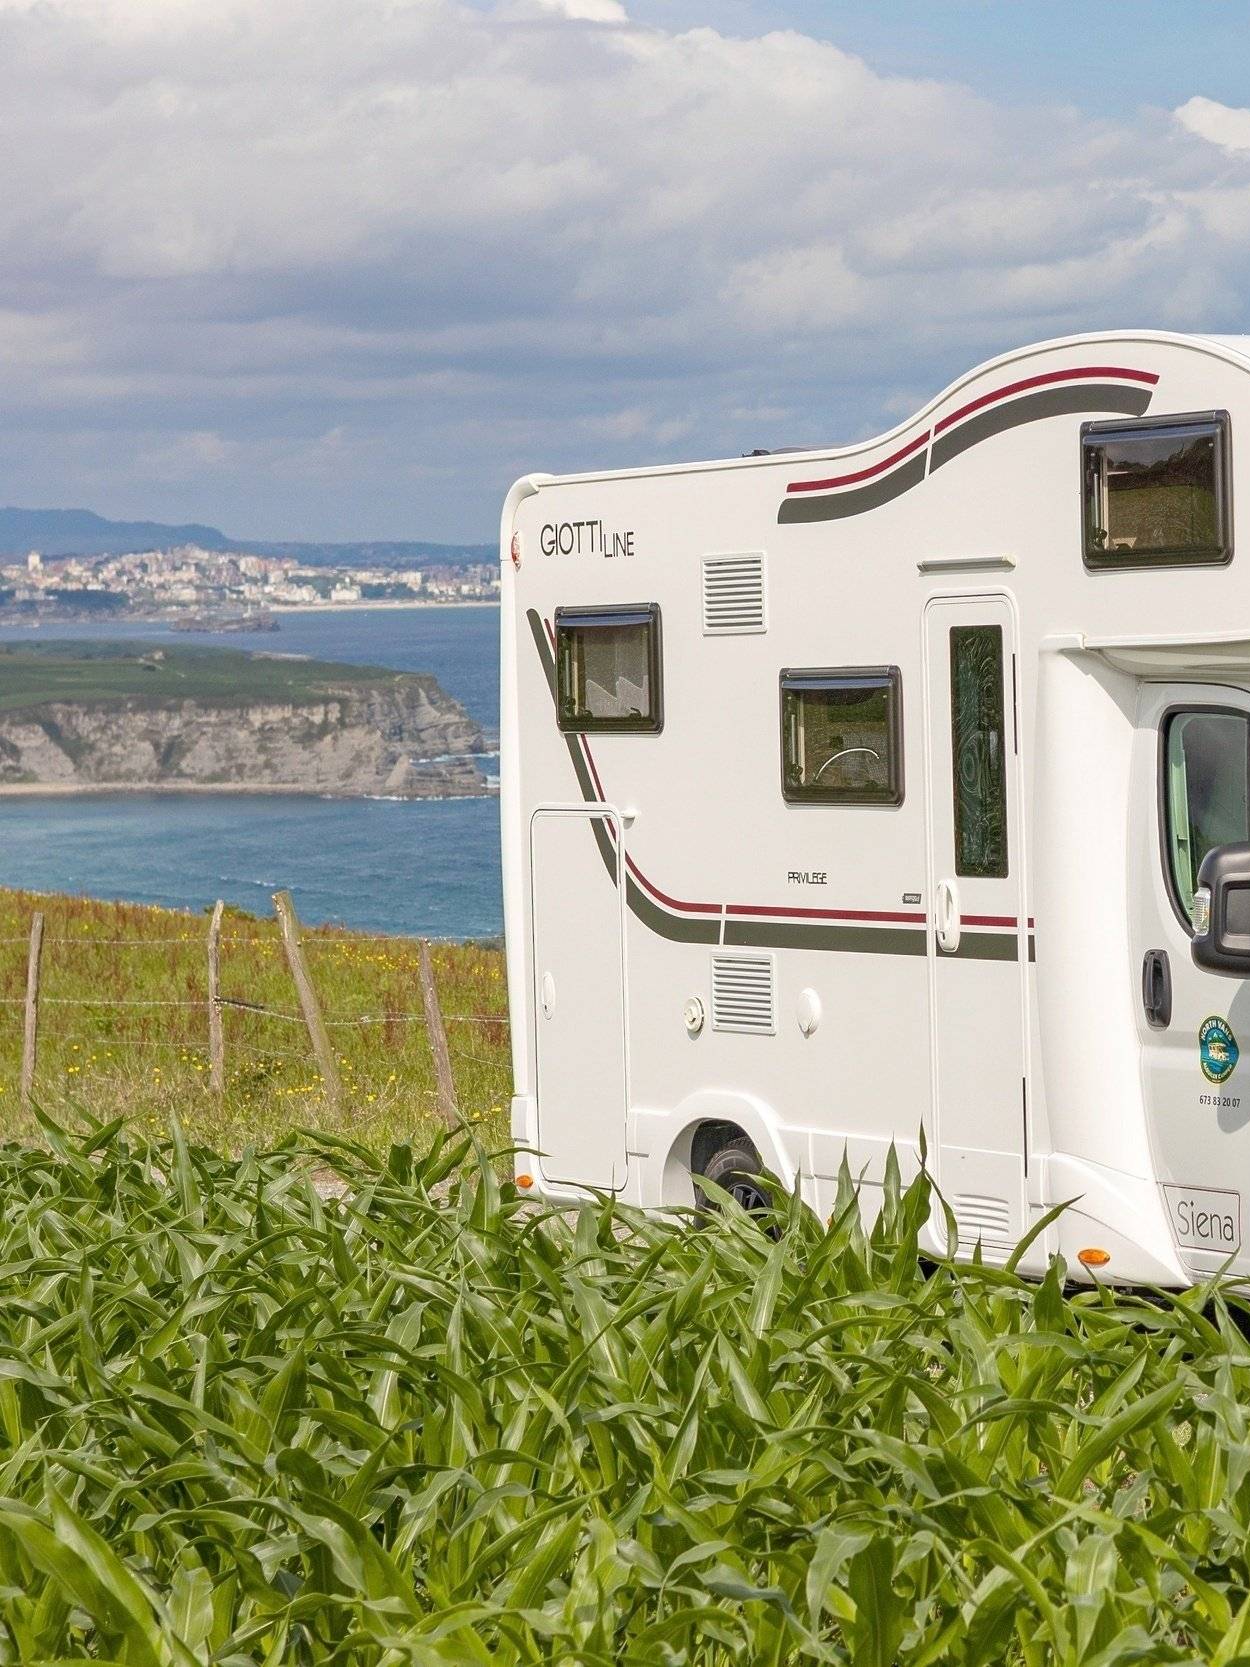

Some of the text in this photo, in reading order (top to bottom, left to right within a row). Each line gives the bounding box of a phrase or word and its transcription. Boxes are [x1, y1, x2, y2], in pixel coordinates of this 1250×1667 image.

[787, 871, 828, 885] PRIVILEGE
[1200, 1019, 1217, 1041] NORTH
[1200, 1095, 1241, 1108] 673 83 20 07
[1177, 1200, 1234, 1242] Siena
